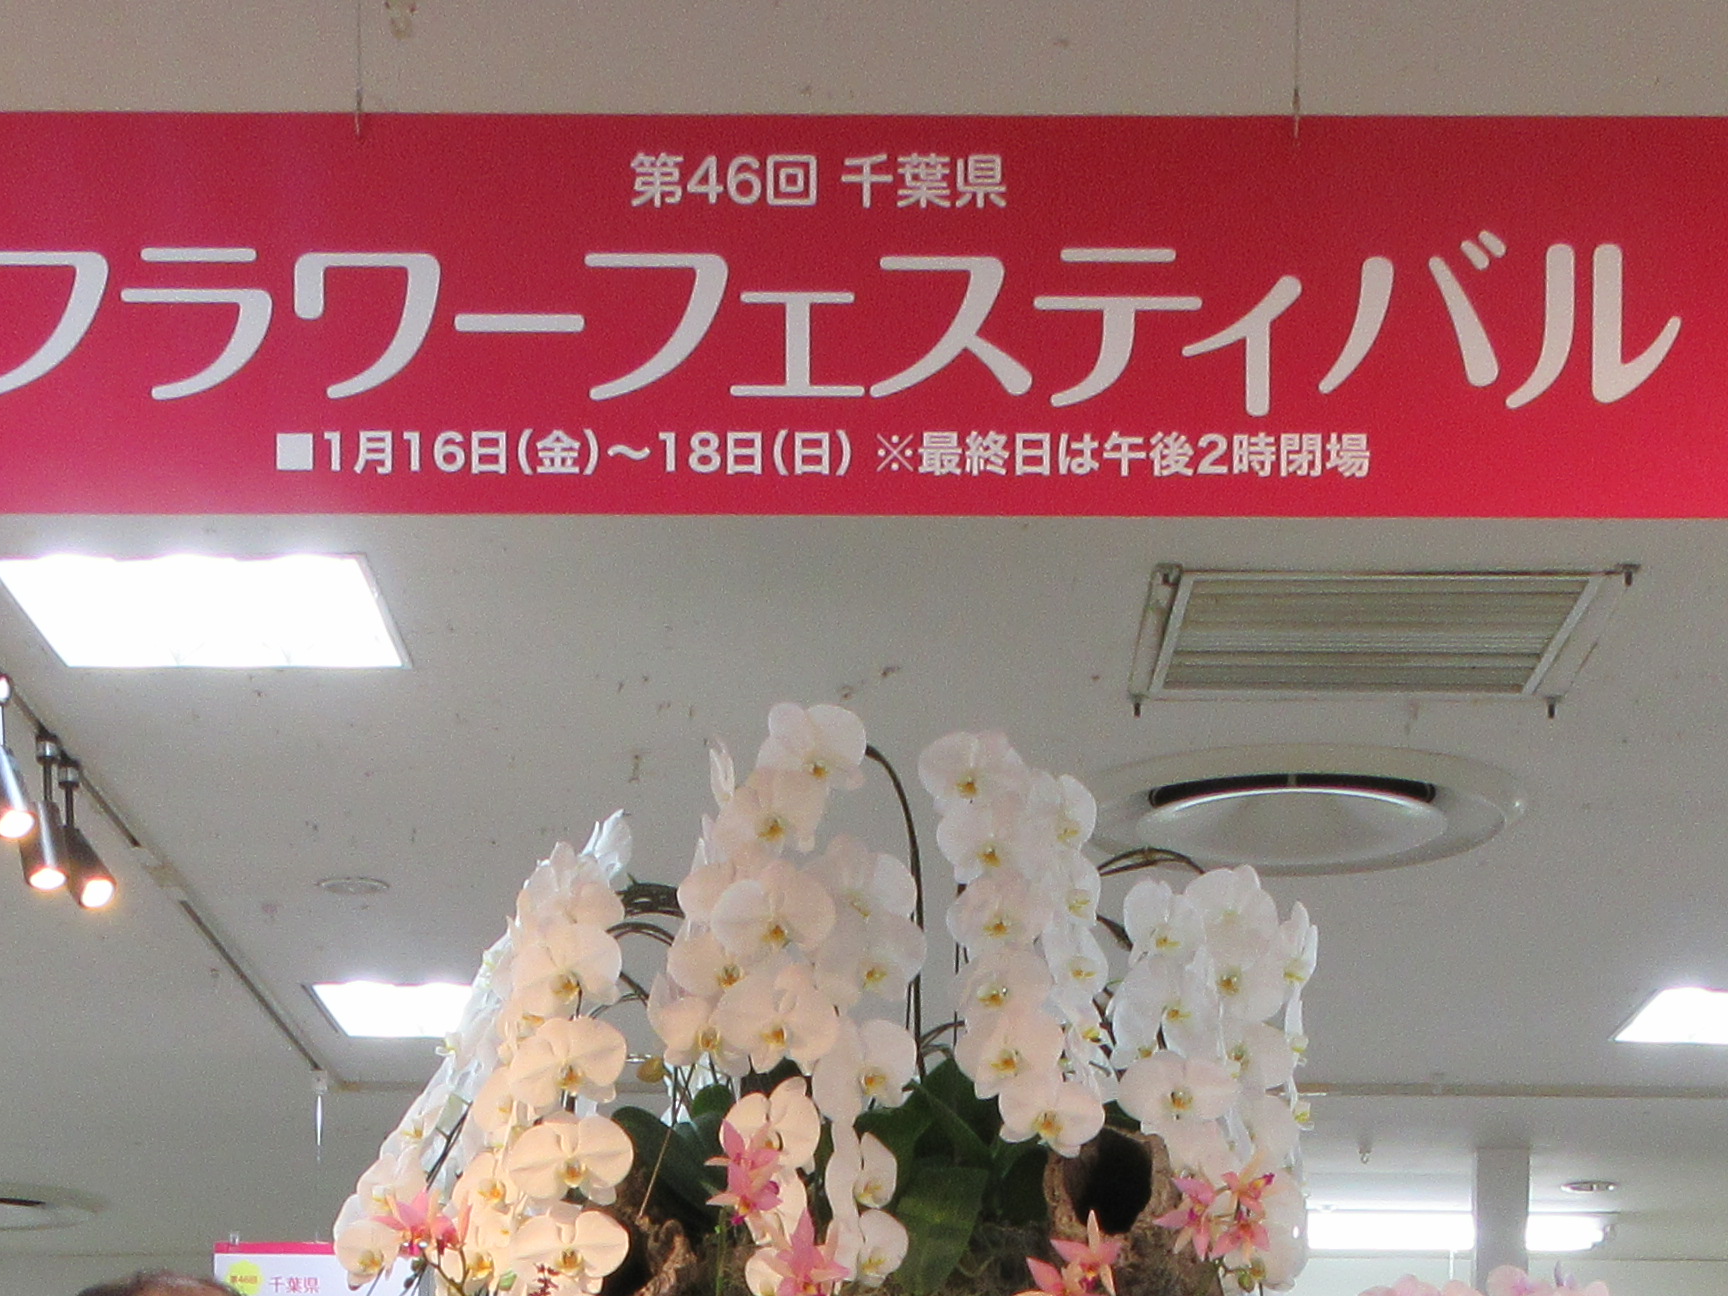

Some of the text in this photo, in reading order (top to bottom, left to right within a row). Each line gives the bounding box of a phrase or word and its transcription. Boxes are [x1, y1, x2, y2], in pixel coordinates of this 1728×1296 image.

[629, 150, 1009, 210] 第46回 千葉県
[269, 1276, 320, 1294] 千葉県
